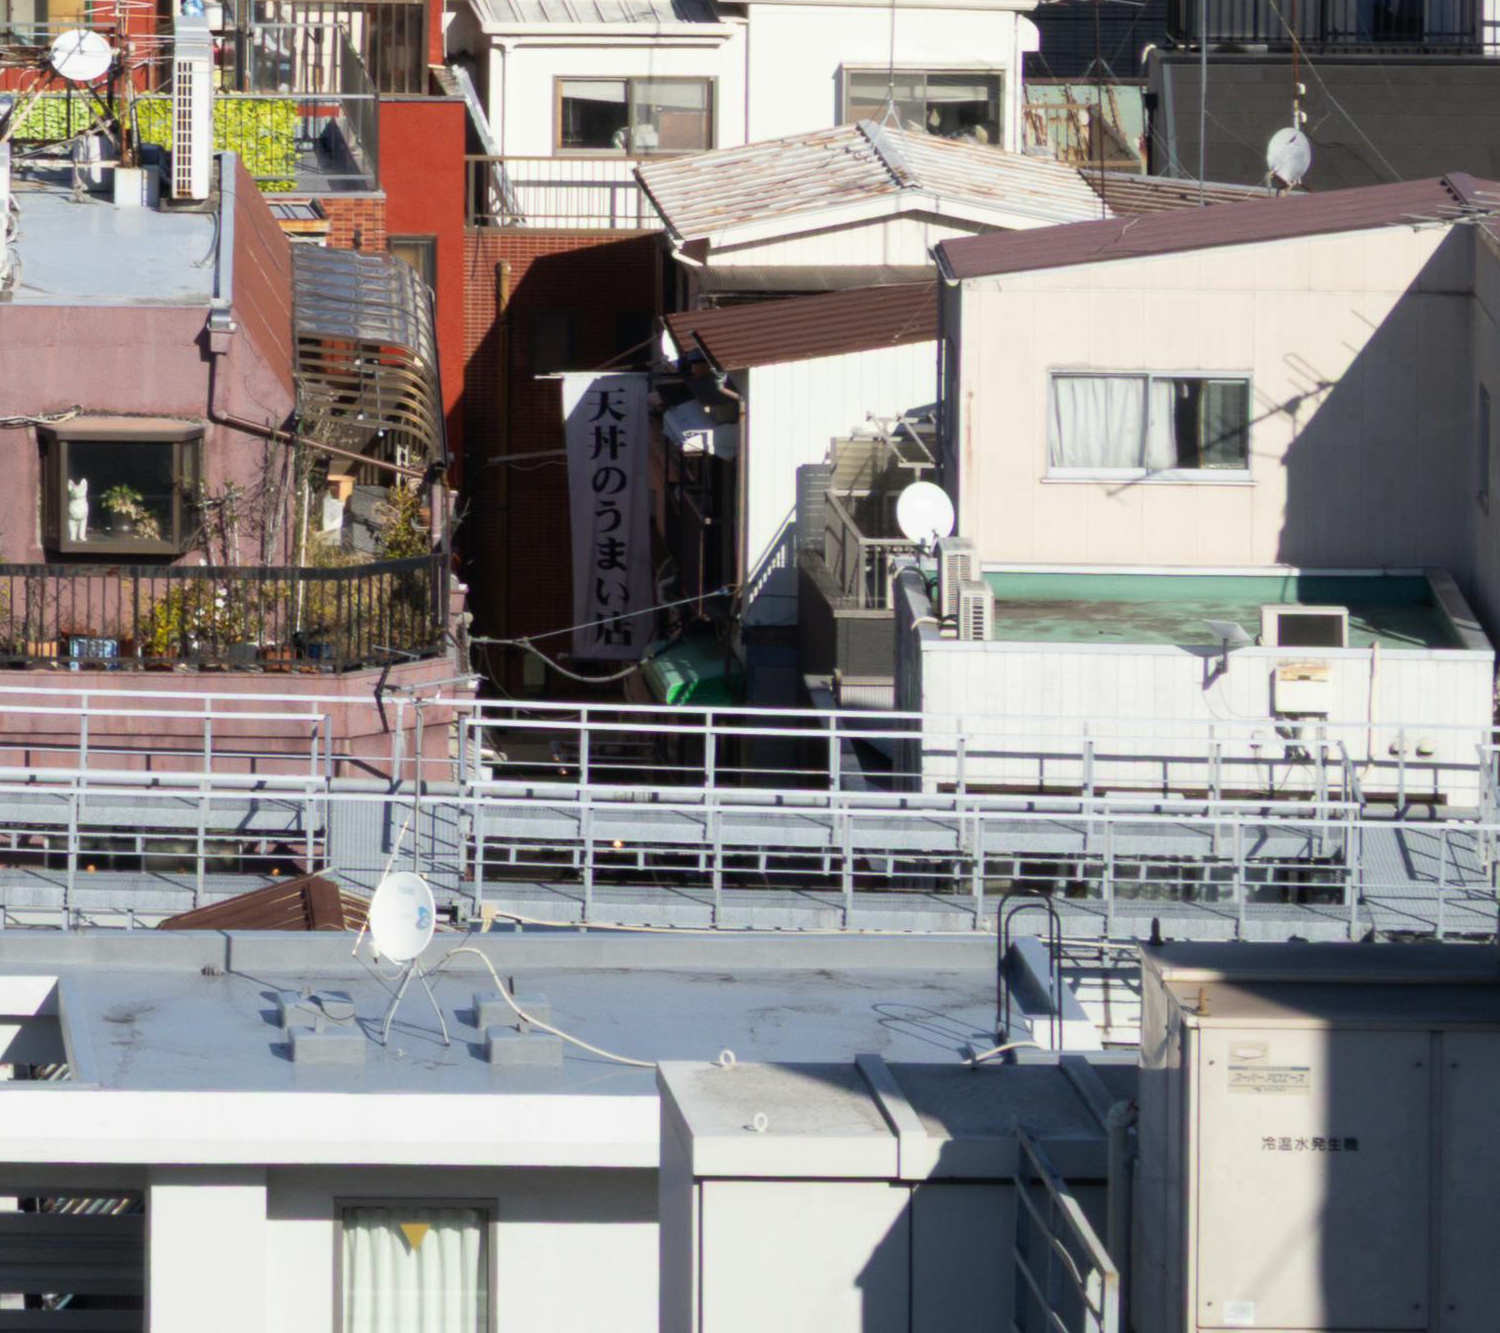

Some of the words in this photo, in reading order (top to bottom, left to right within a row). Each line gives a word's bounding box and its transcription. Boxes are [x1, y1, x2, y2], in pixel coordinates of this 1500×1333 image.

[587, 388, 632, 647] 天丼のうまい店
[1262, 1136, 1359, 1153] 冷温水発生機
